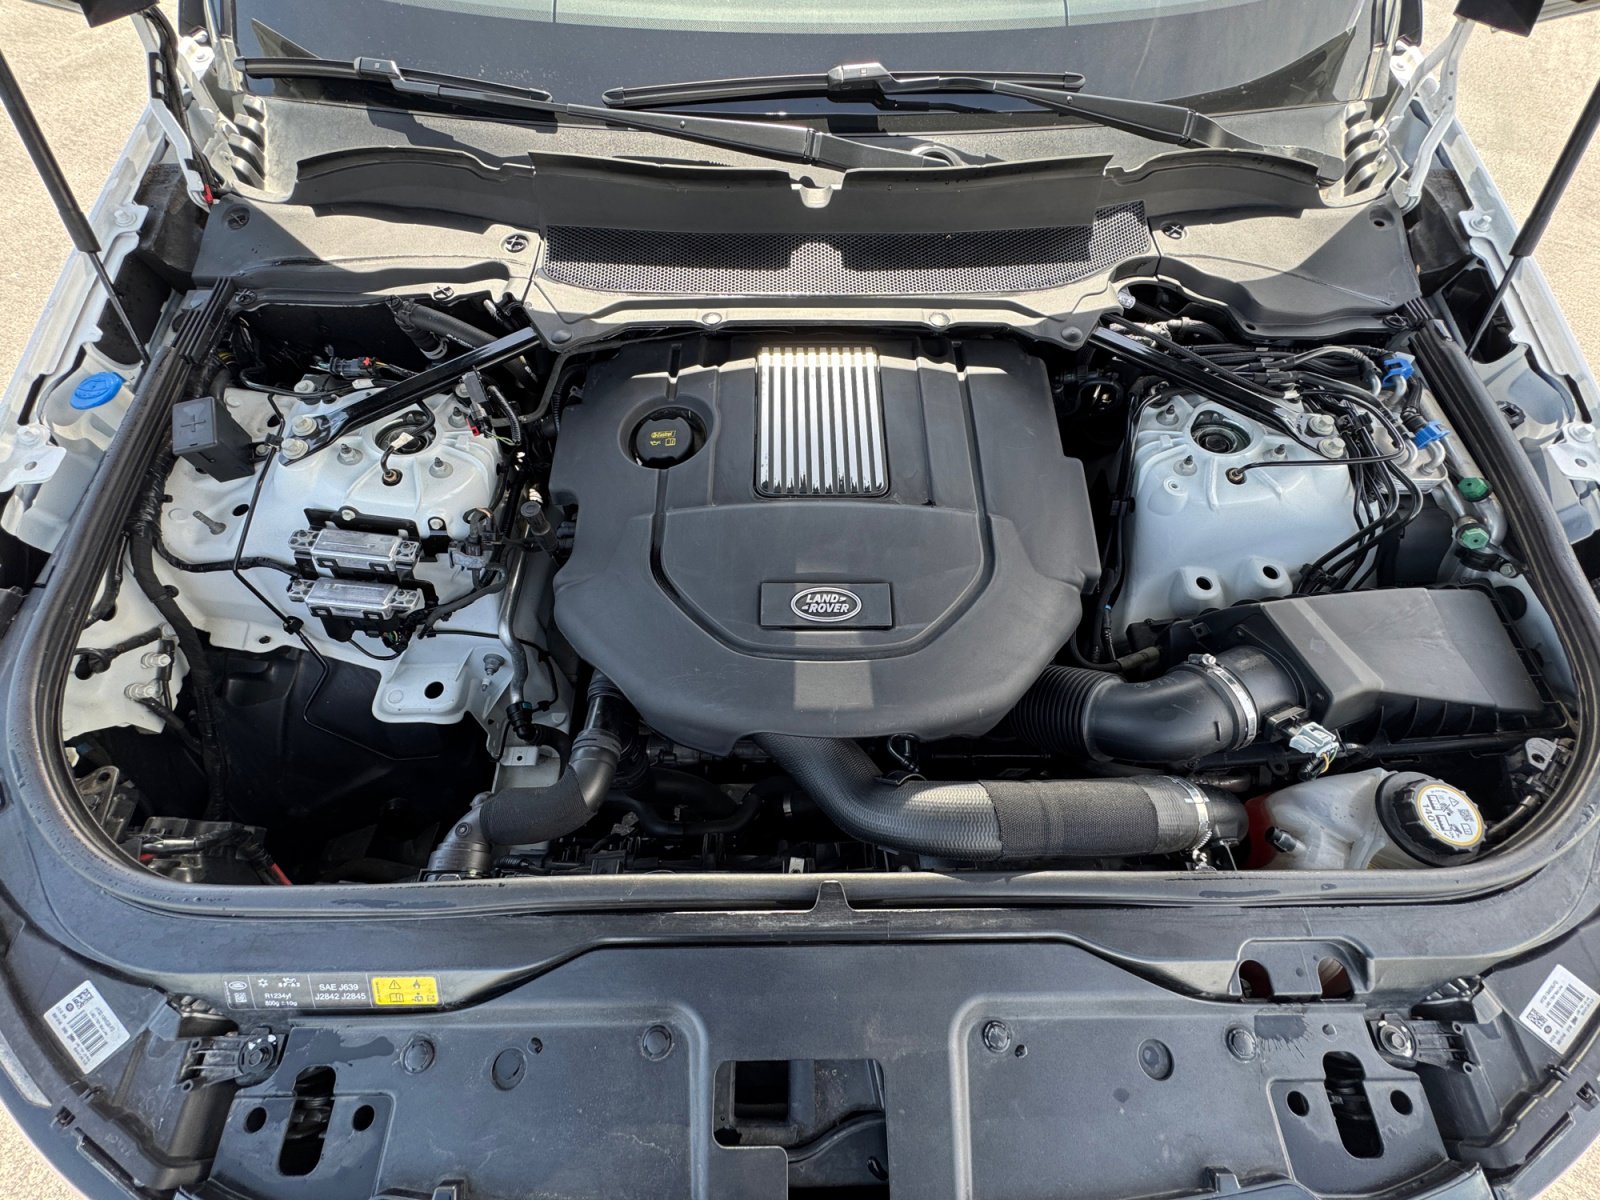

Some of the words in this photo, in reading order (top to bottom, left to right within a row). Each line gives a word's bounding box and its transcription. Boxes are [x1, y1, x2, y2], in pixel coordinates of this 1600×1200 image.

[806, 594, 839, 603] LAND
[808, 603, 849, 613] ROVER
[319, 983, 337, 991] SAE
[338, 983, 358, 991] J639
[314, 992, 339, 1000] J2842
